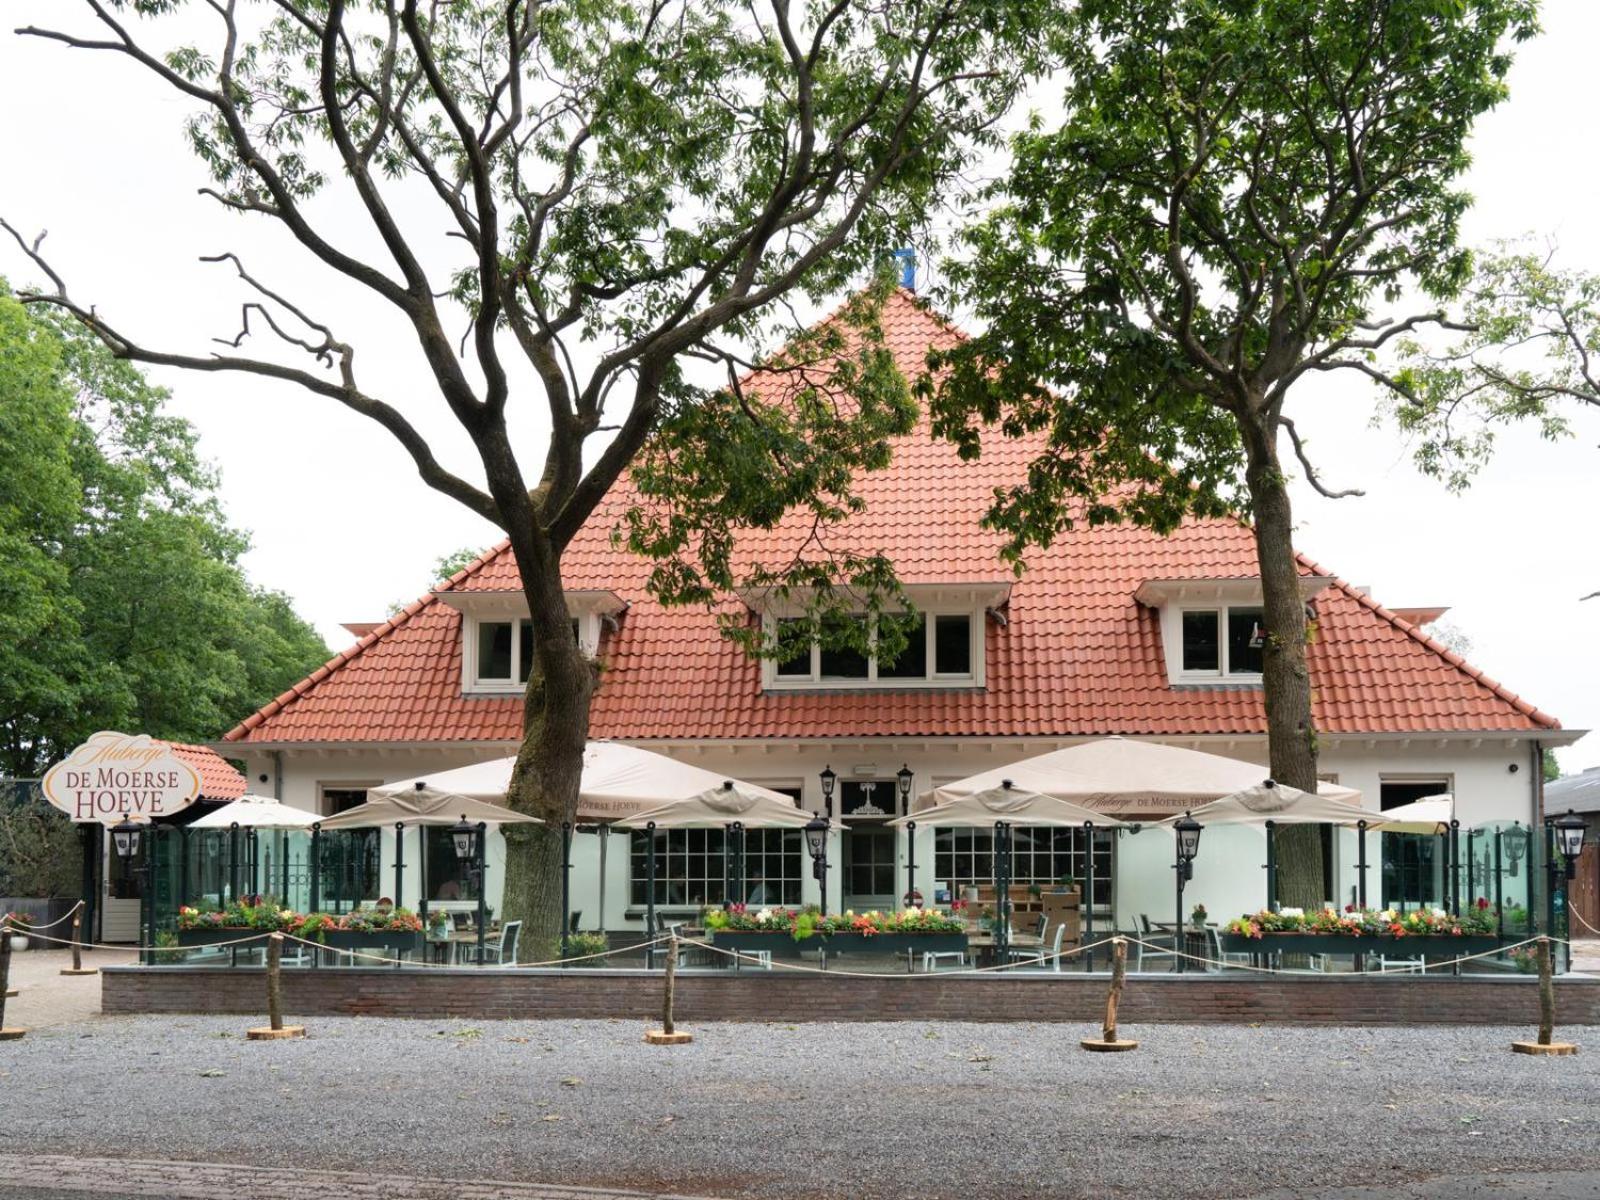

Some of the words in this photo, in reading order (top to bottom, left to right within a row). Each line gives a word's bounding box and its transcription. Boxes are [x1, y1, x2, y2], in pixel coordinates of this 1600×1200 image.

[74, 736, 165, 770] Auberge
[66, 772, 91, 788] DE
[97, 768, 179, 788] MOERSE
[76, 791, 164, 819] HOEVE
[1137, 799, 1149, 807] DE
[1151, 797, 1188, 807] MOERSE
